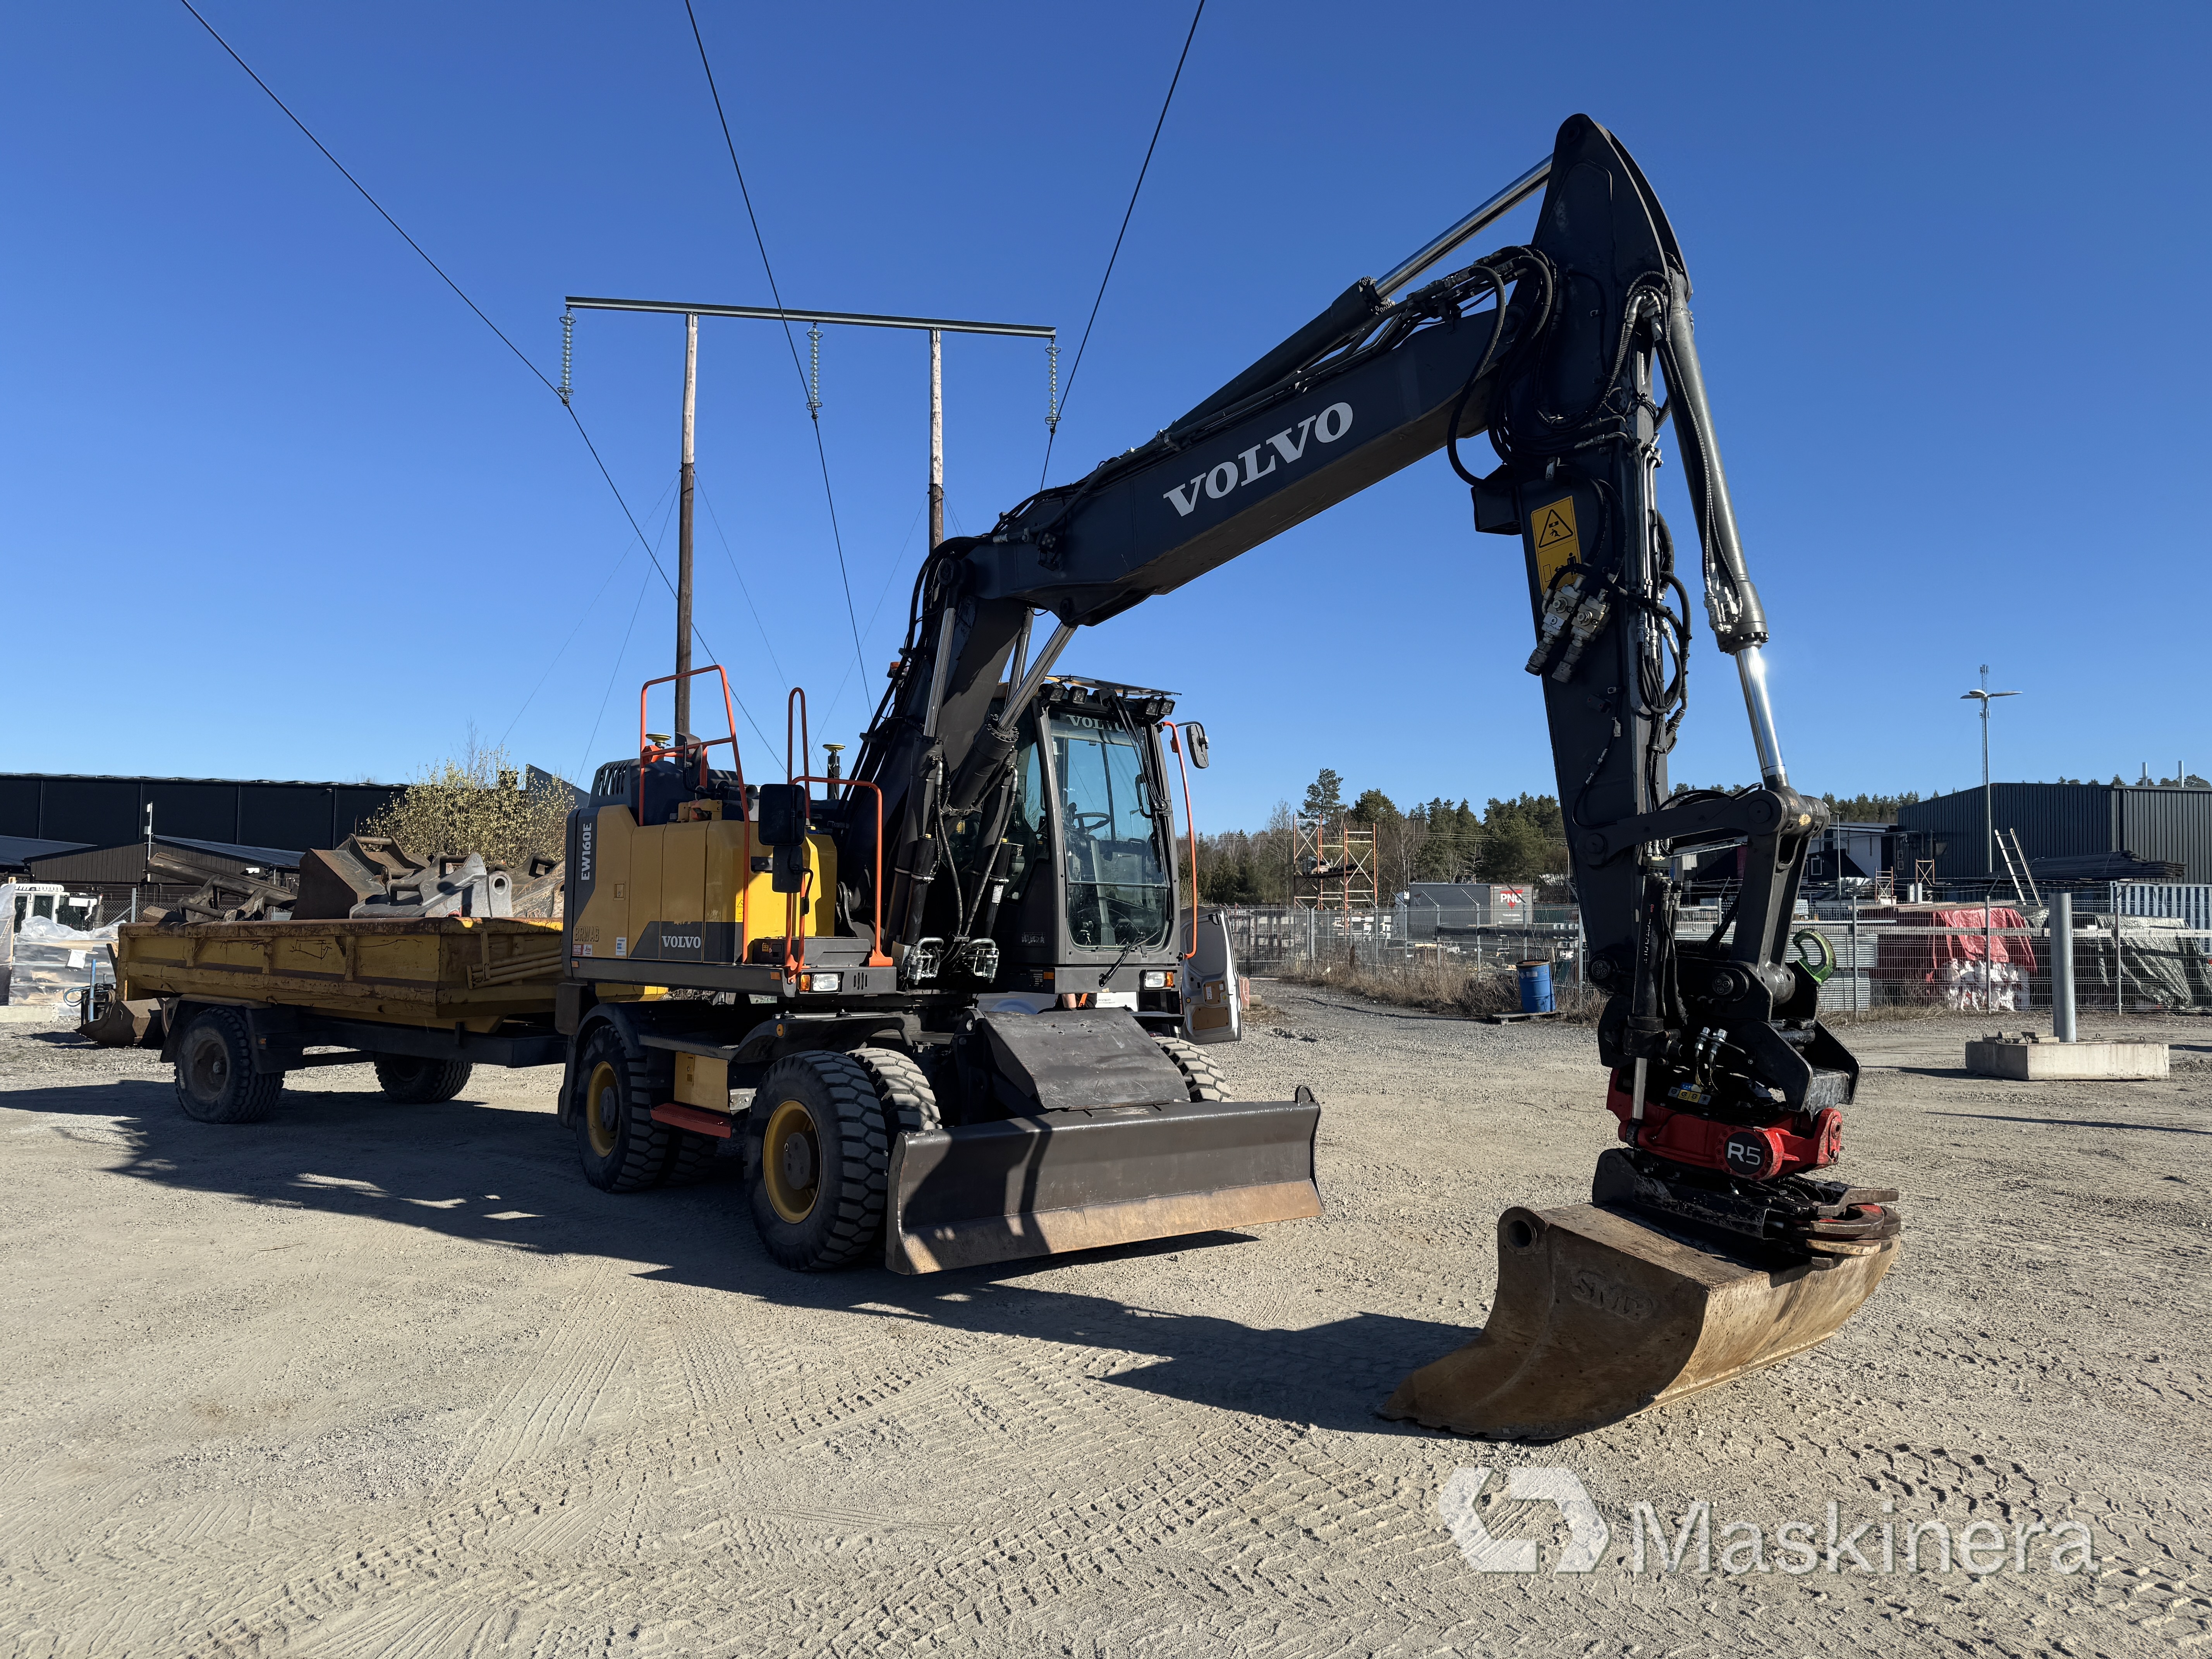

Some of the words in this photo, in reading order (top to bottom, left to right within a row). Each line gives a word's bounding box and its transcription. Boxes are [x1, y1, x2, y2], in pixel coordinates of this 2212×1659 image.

[1163, 402, 1353, 517] VOLVO
[581, 823, 591, 880] EW160E
[1500, 893, 1522, 903] PNO
[661, 936, 701, 948] VOLVO
[1728, 1142, 1760, 1165] R5
